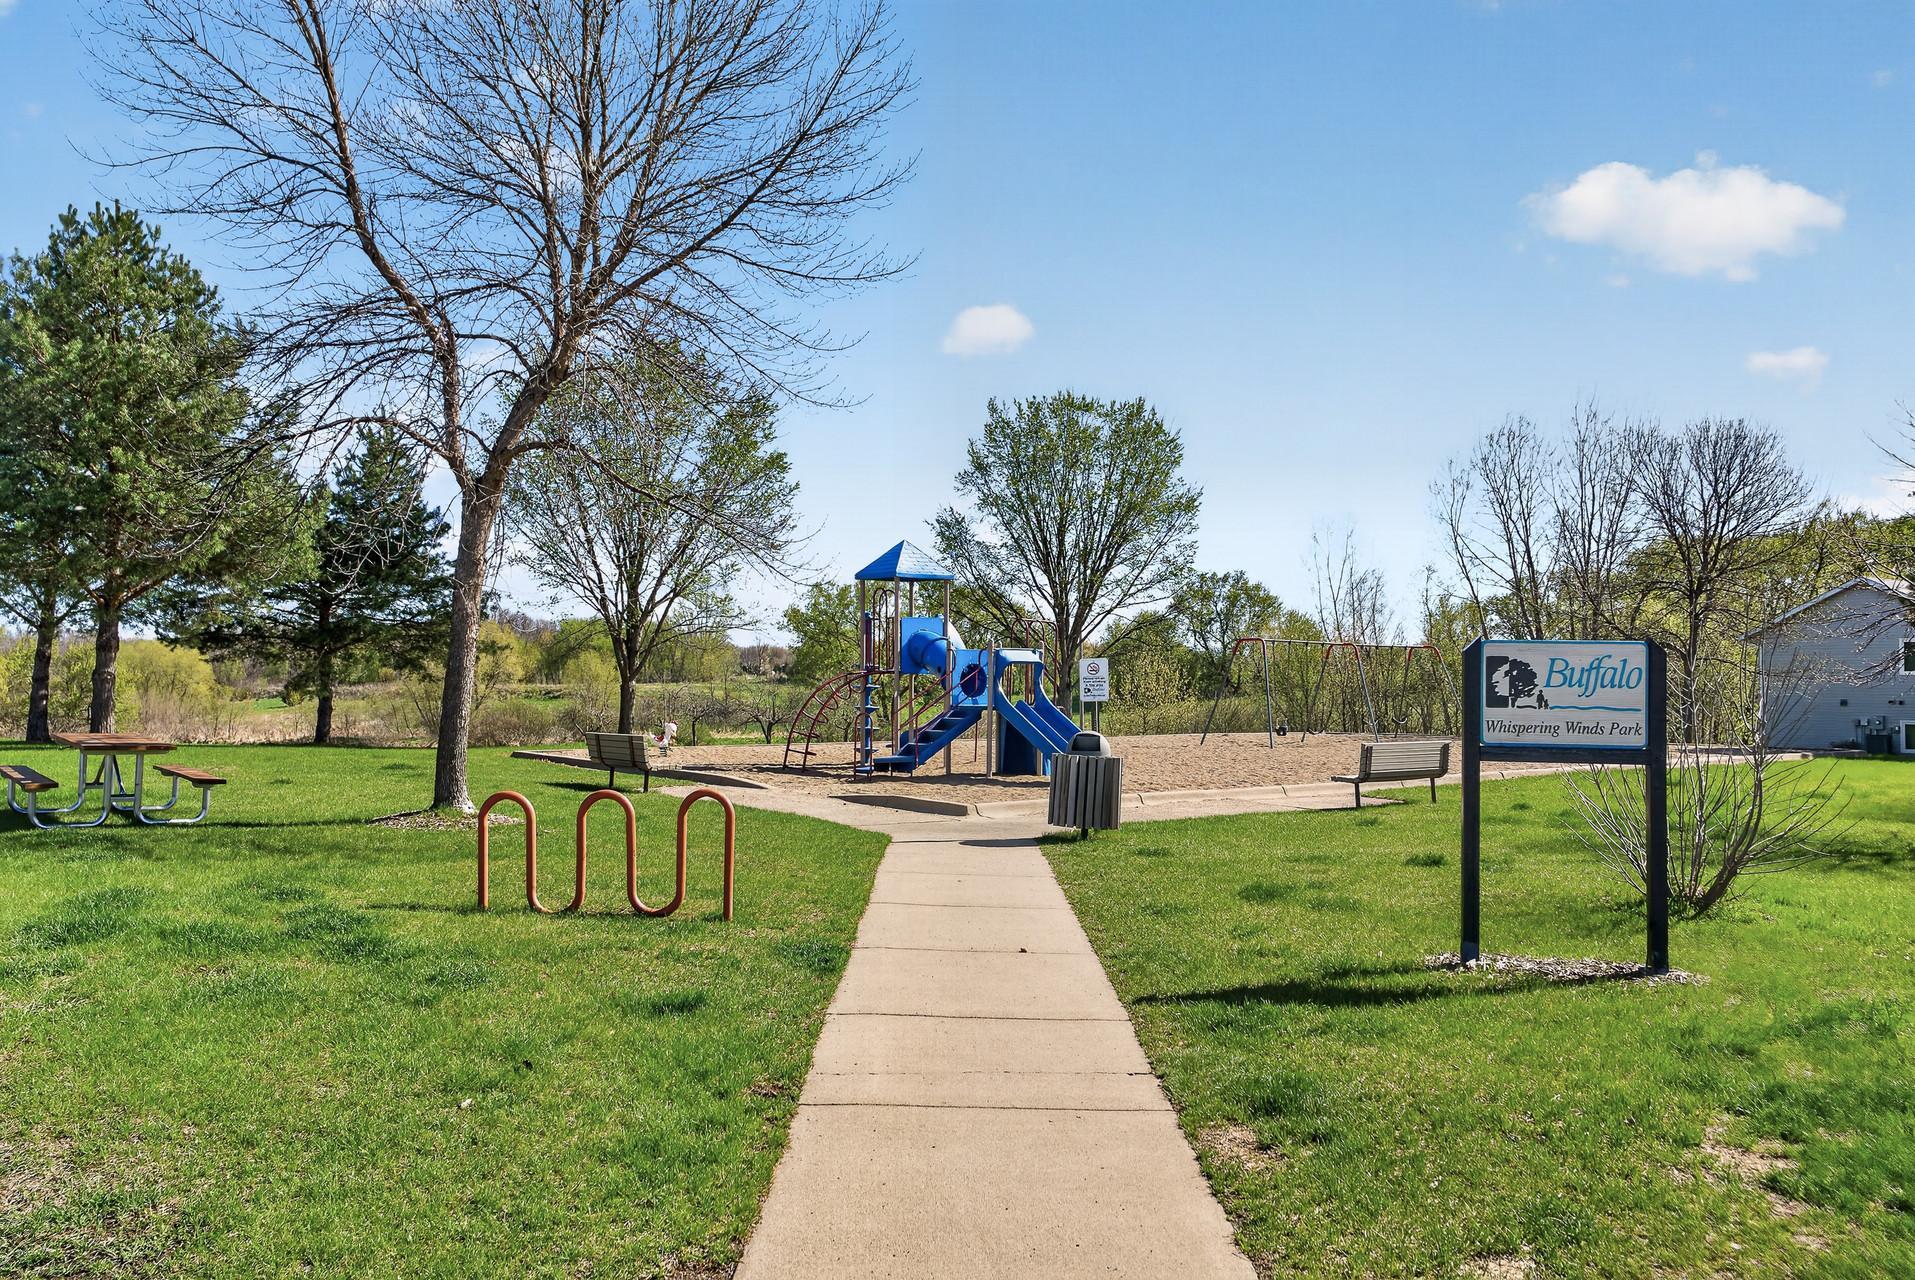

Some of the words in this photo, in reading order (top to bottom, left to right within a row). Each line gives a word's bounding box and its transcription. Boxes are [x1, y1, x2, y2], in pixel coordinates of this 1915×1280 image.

[1543, 654, 1642, 698] Buffalo
[1485, 720, 1560, 737] Whispering
[1565, 721, 1605, 736] Winds
[1608, 722, 1642, 736] Park
